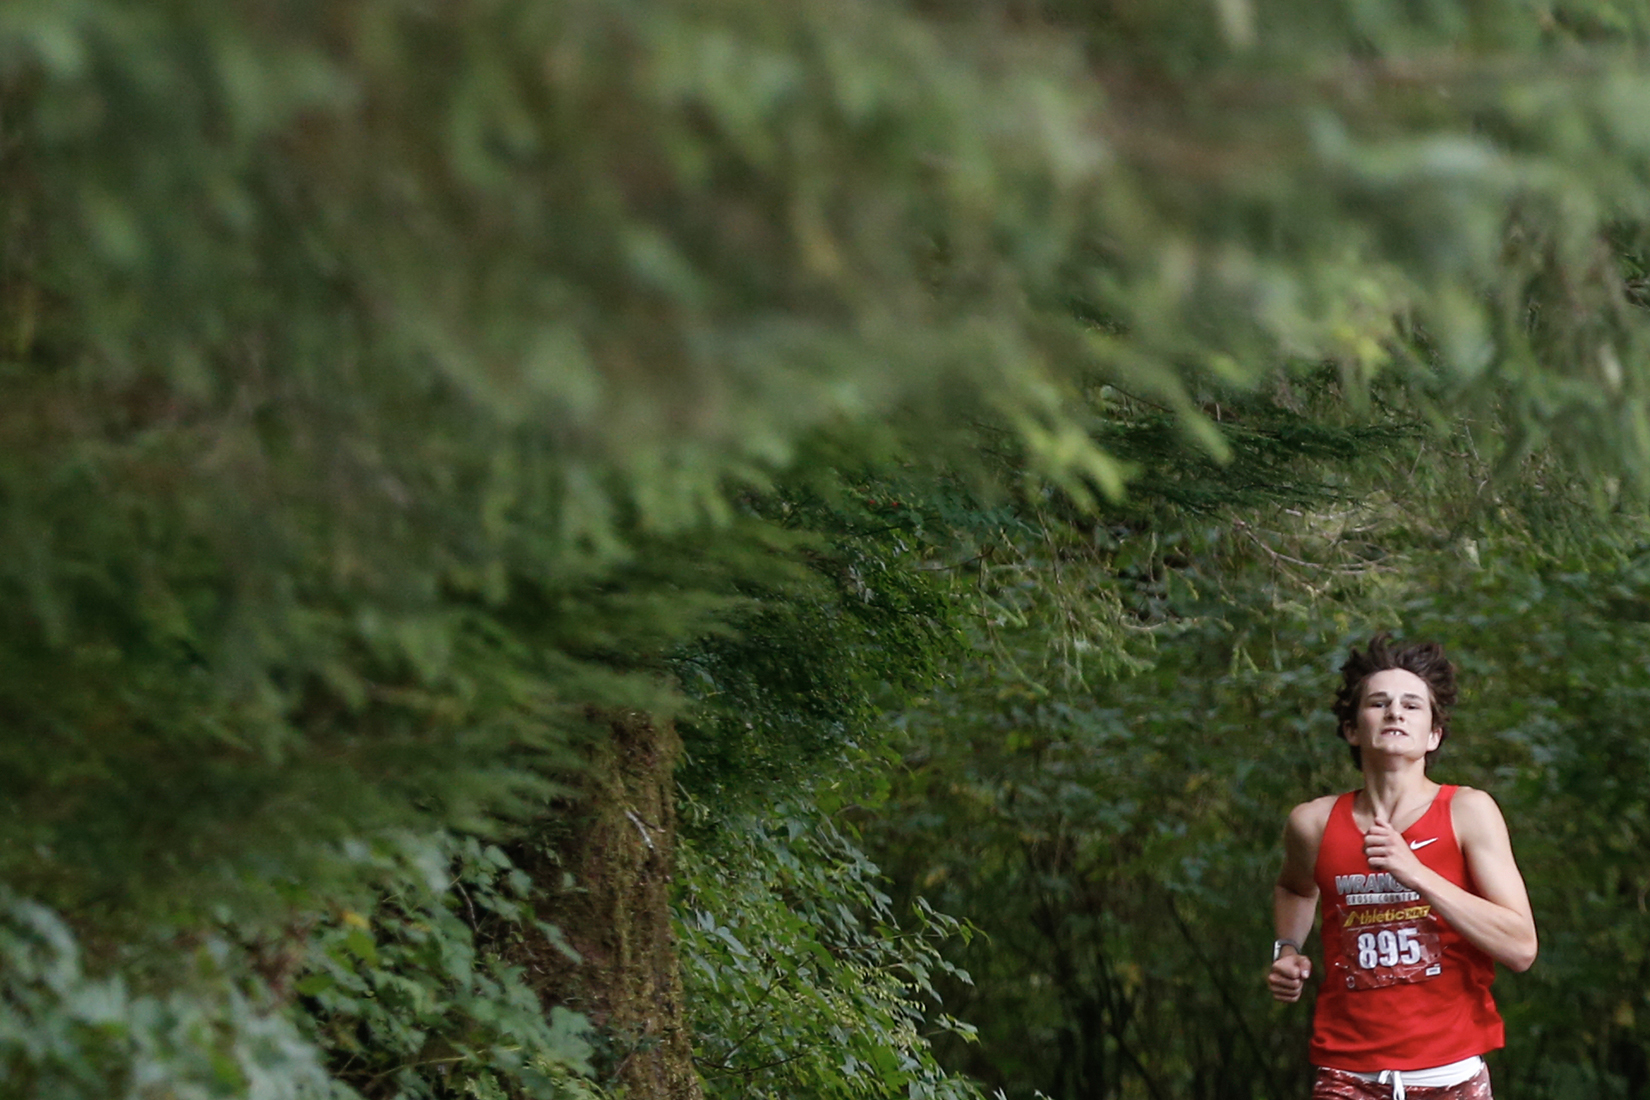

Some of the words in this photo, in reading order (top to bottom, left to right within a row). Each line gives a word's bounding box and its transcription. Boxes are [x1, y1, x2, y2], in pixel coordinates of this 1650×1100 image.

[1335, 873, 1411, 894] WRANG
[1346, 896, 1373, 905] CROSS
[1358, 928, 1421, 969] 895
